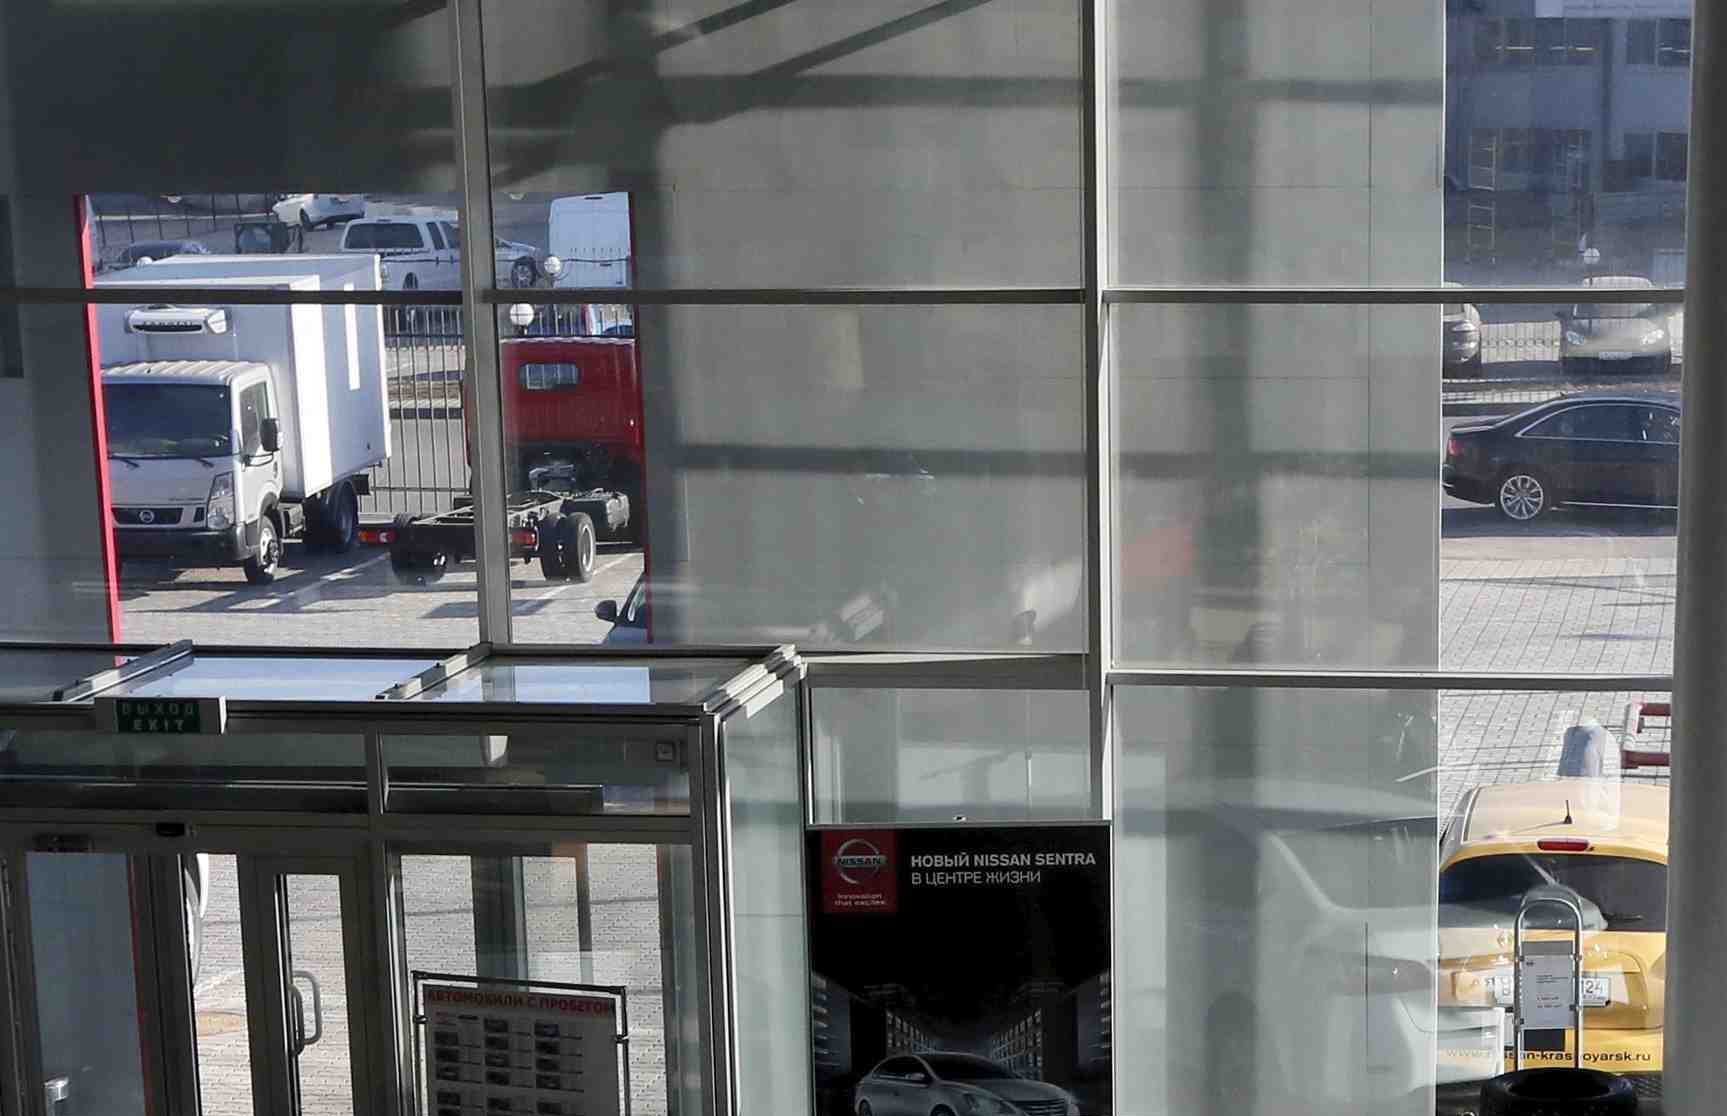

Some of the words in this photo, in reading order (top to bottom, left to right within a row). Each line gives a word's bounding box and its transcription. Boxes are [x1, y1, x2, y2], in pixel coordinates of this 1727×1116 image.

[121, 702, 194, 715] ВЫХОД
[133, 719, 185, 731] EXIT
[910, 852, 970, 868] НОВЫЙ
[973, 853, 1032, 867] NISSAN
[1034, 852, 1097, 866] SENTRA
[911, 872, 921, 885] В
[925, 871, 982, 887] ЦЕНТРЕ
[985, 870, 1042, 885] ЖИЗНИ
